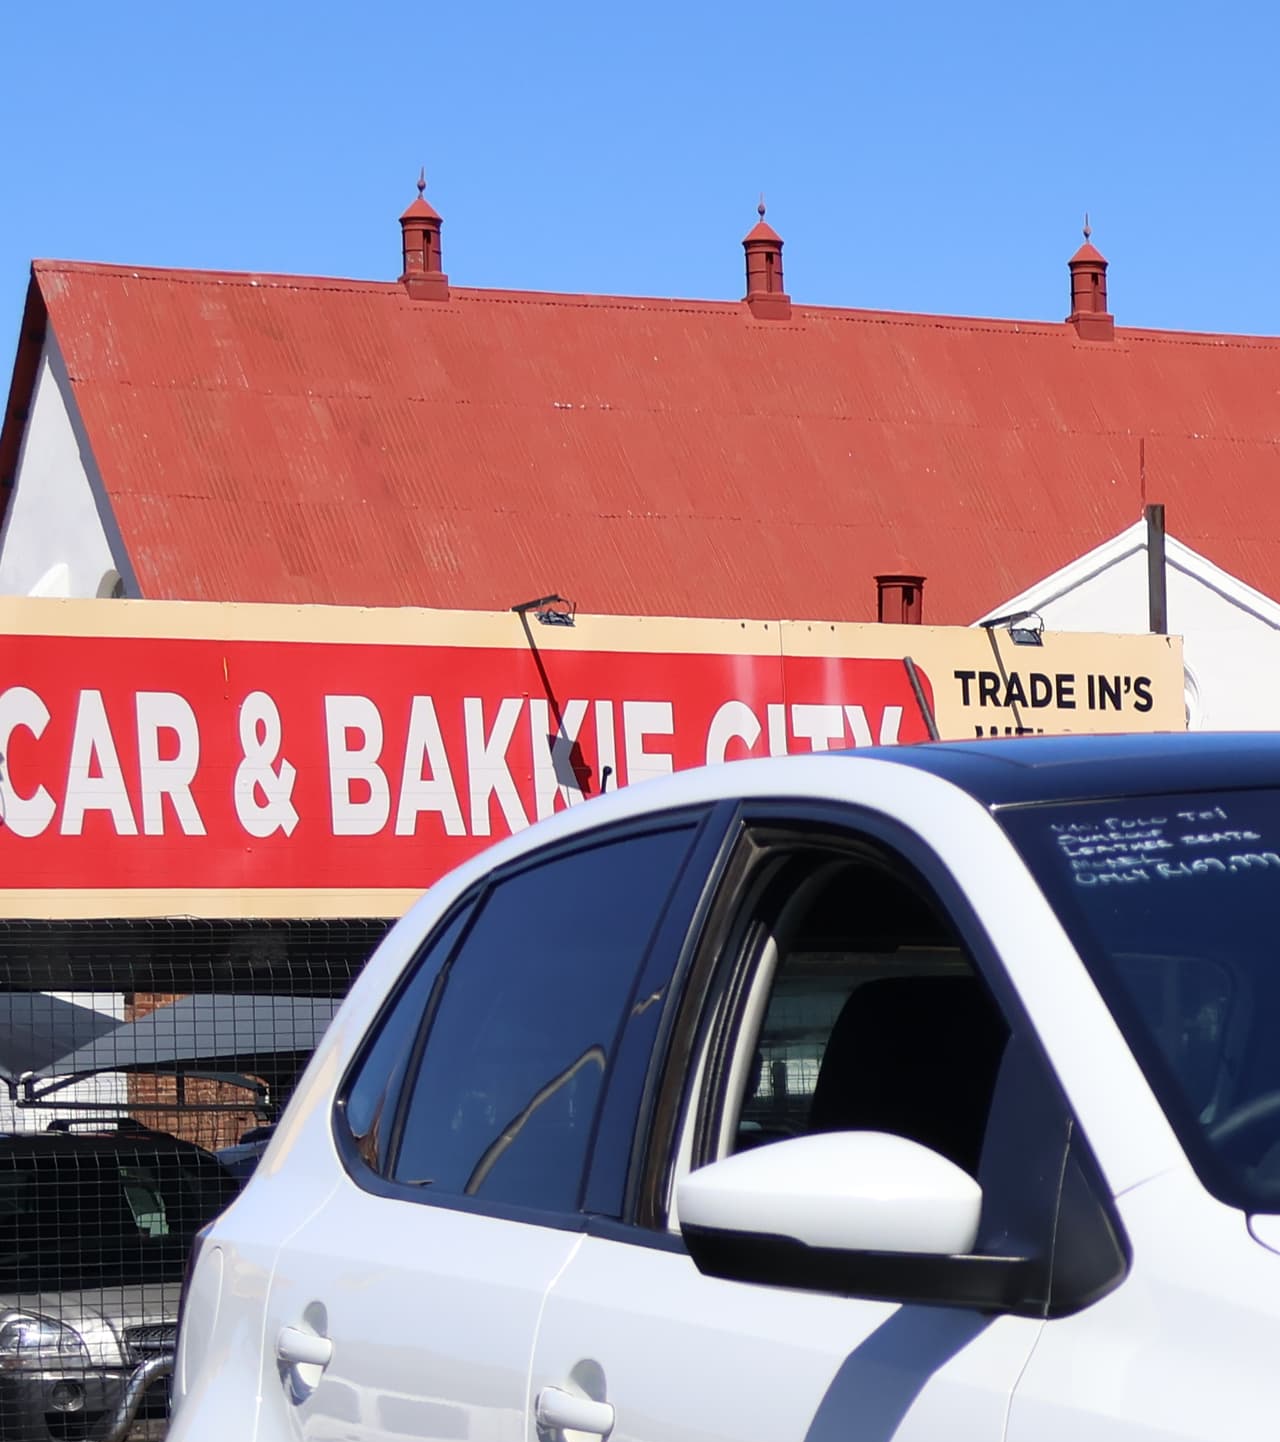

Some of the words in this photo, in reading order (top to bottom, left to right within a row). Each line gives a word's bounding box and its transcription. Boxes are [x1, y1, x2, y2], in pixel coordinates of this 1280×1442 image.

[954, 670, 1077, 709] TRADE
[1087, 674, 1154, 713] IN'S
[0, 686, 208, 838] CAR
[234, 690, 300, 838] &
